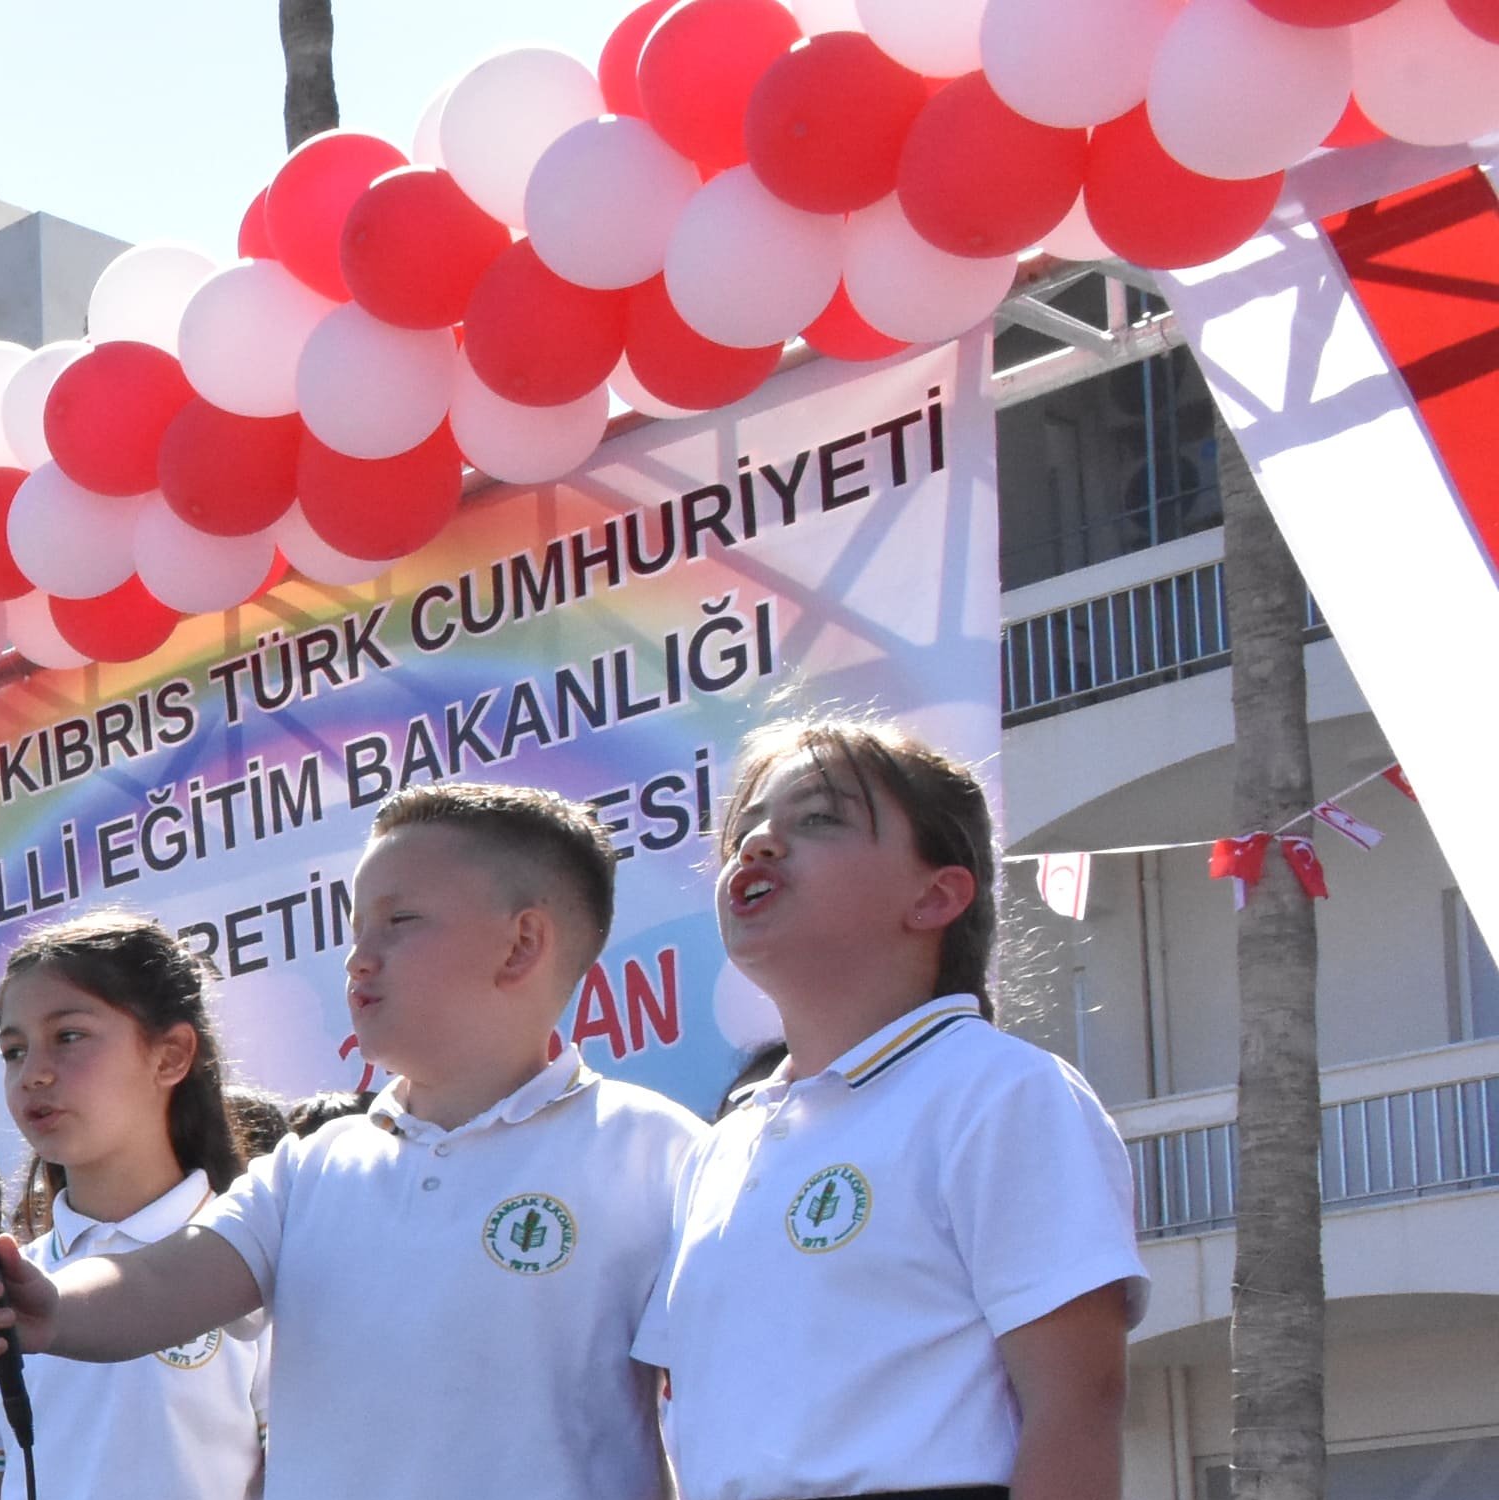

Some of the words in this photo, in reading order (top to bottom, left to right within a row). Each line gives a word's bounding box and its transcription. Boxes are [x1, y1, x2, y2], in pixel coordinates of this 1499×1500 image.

[0, 682, 195, 802] KIBRIS
[209, 603, 392, 724] TÜRK
[410, 385, 946, 653] CUMHURİYETİ
[97, 758, 323, 889] EĞİTİM
[344, 595, 774, 808] BAKANLIĞI
